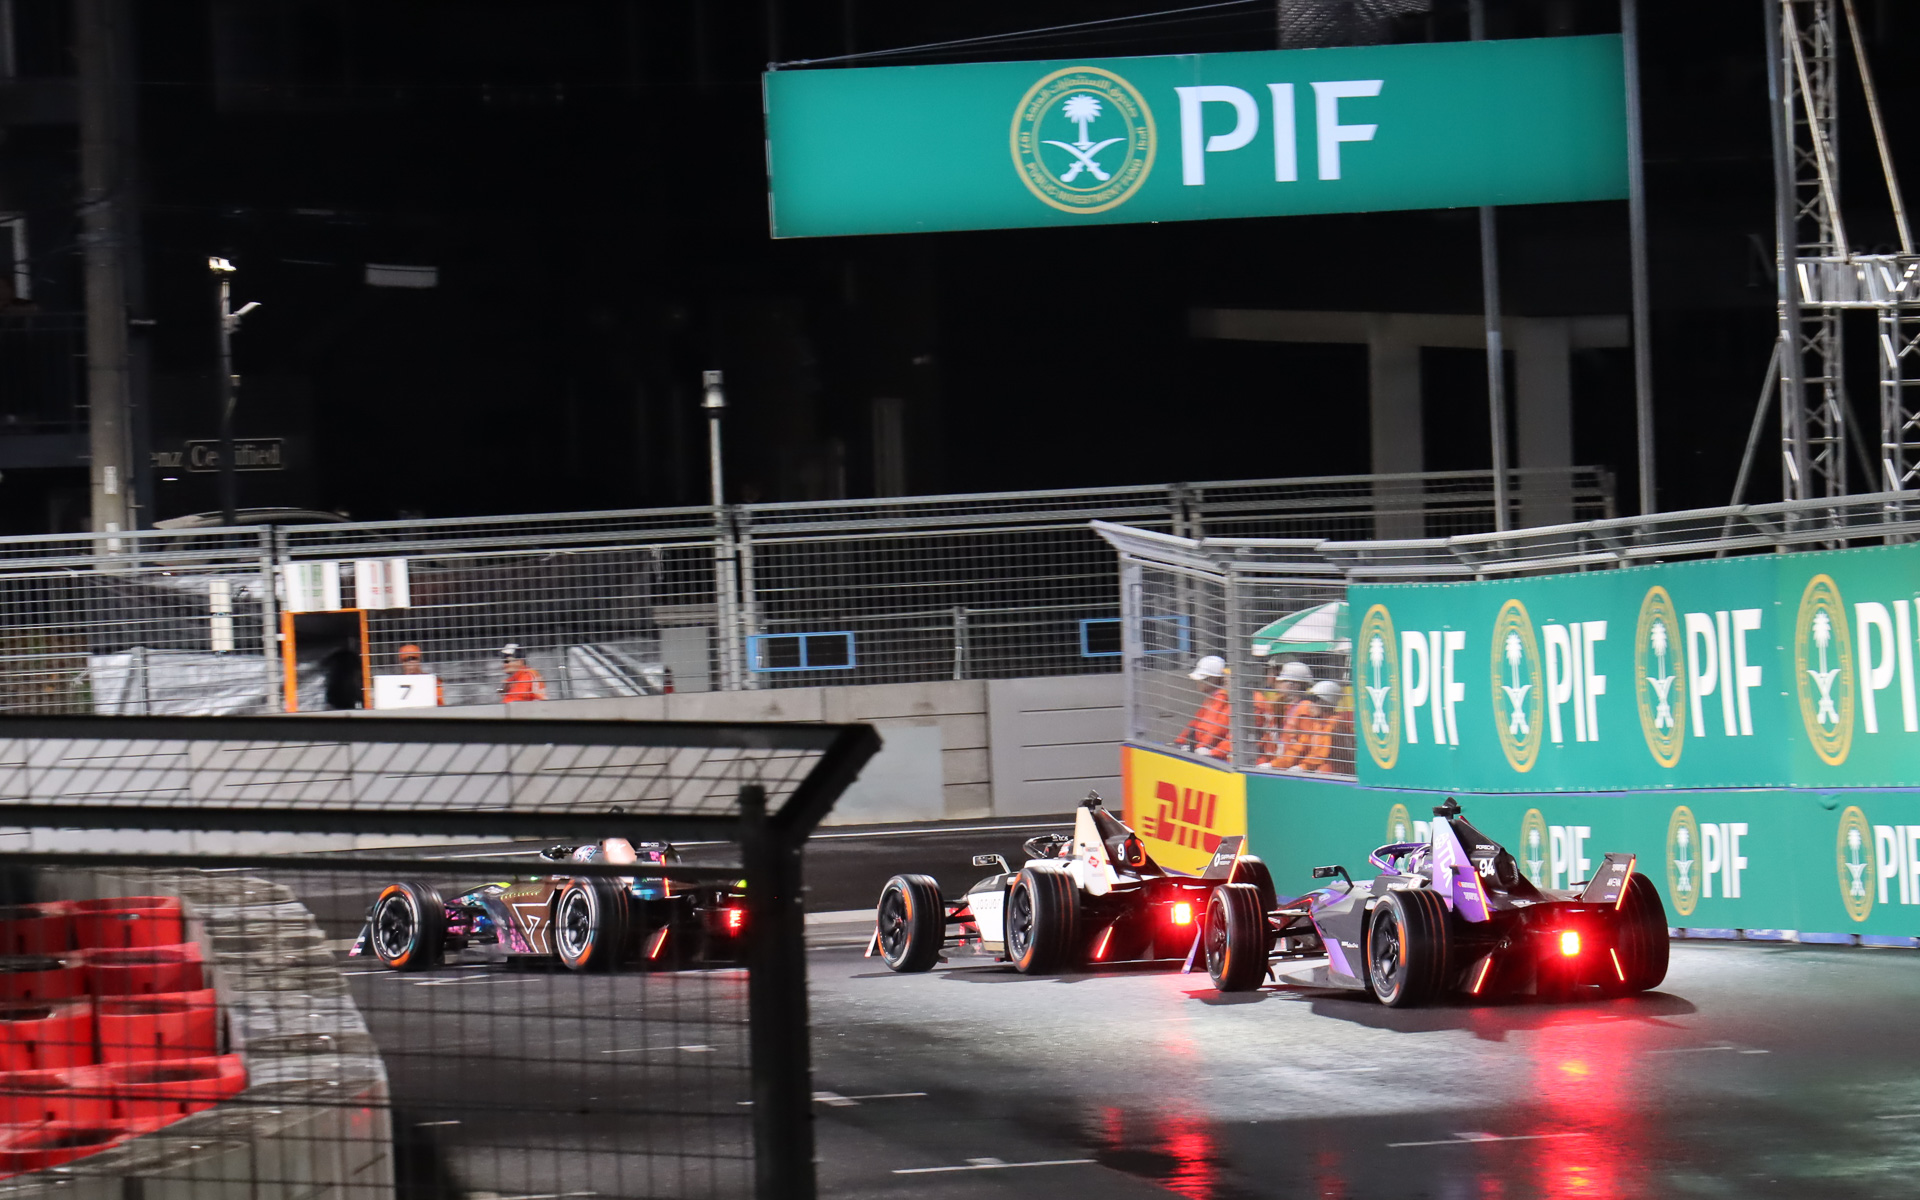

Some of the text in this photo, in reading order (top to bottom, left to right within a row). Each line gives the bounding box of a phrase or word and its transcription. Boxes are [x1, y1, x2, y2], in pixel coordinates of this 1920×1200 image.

[1174, 79, 1384, 186] PIF
[191, 443, 280, 467] Ceified
[398, 684, 412, 700] 7
[1401, 630, 1466, 746] PIF
[1541, 620, 1608, 743] PIF
[1684, 608, 1762, 737] PIF
[1854, 597, 1920, 733] PI
[1117, 843, 1125, 861] 9
[1154, 780, 1222, 855] DHL
[1479, 857, 1495, 877] 94
[1548, 825, 1591, 891] PIF
[1700, 823, 1748, 898] PIF
[1873, 825, 1920, 905] PIF
